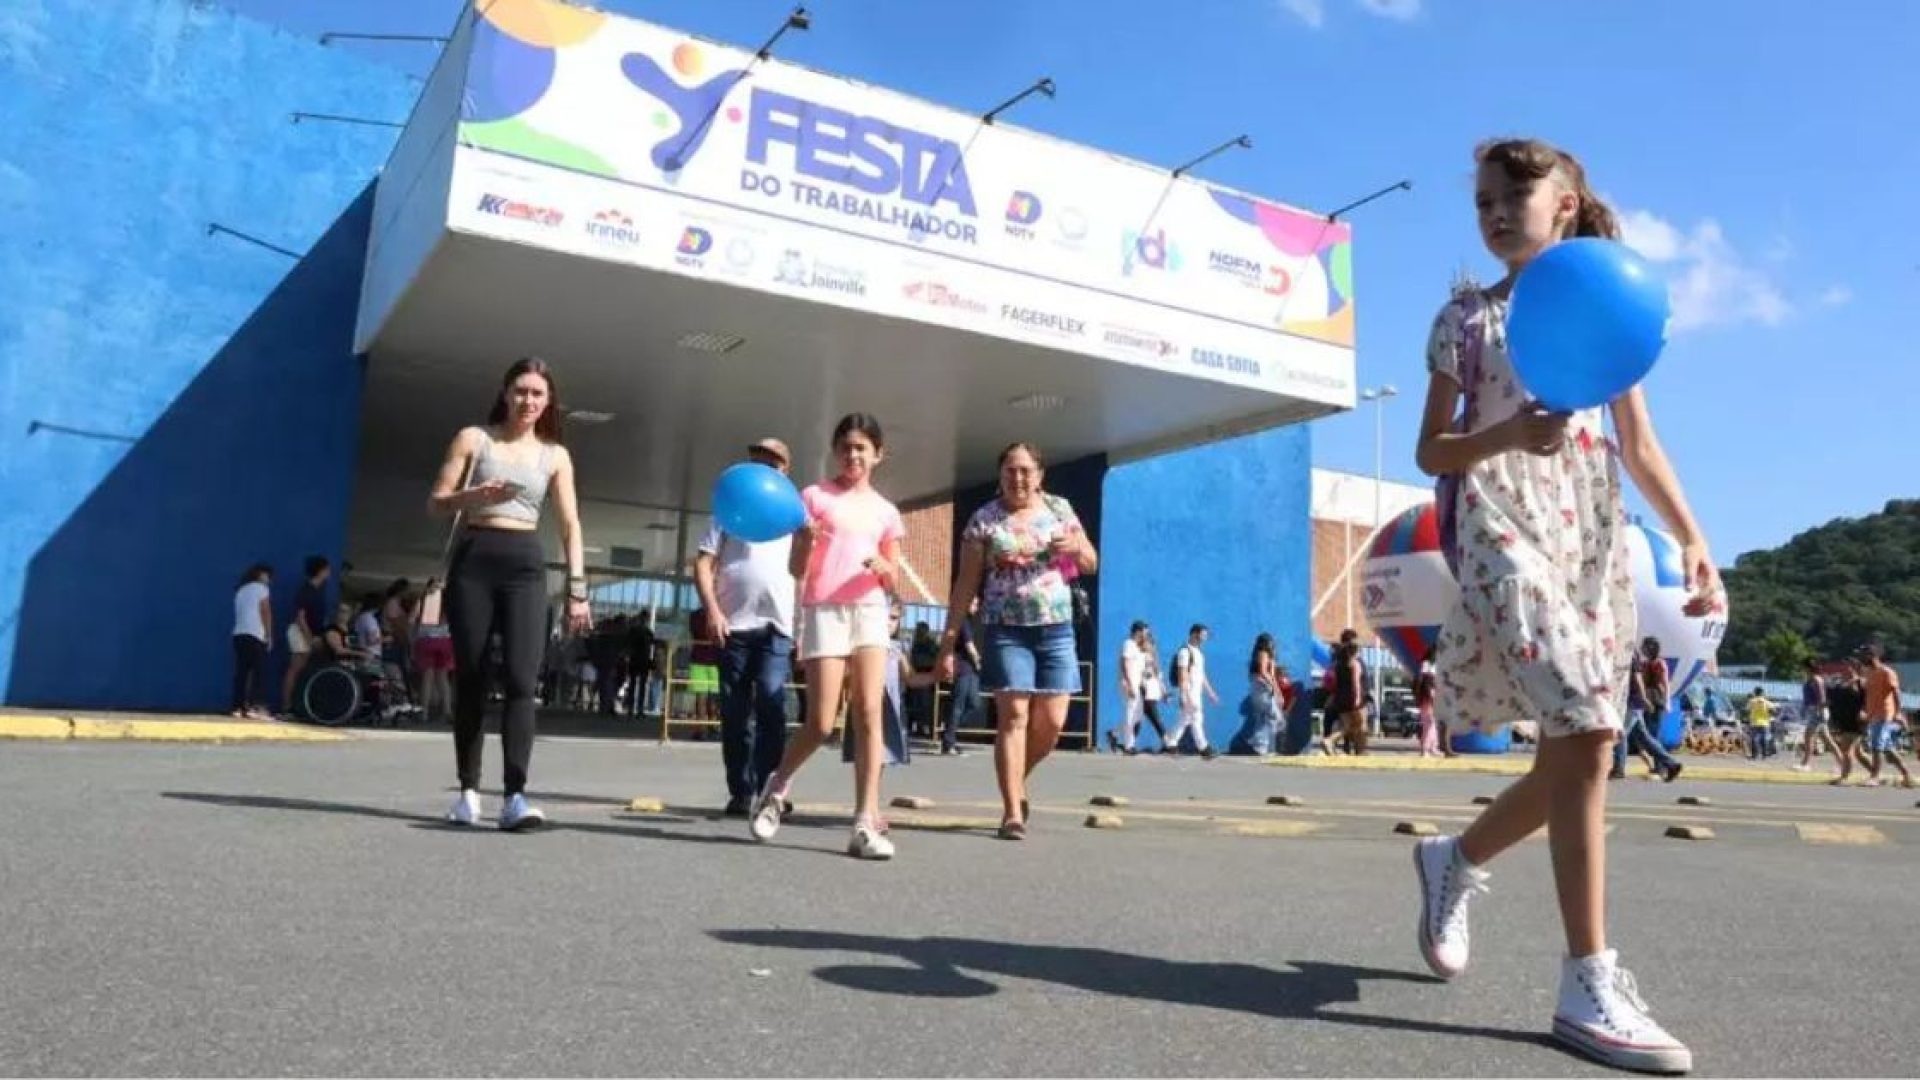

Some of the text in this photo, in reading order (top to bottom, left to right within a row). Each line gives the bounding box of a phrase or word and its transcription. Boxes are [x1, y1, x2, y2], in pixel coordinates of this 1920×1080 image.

[746, 86, 978, 217] FESTA
[740, 169, 781, 197] DO
[790, 181, 977, 244] TRABALHADOR
[1004, 223, 1036, 241] NDTV
[811, 270, 866, 297] Joinville
[1001, 303, 1086, 336] FAGERFLEX
[1190, 346, 1225, 369] CASA
